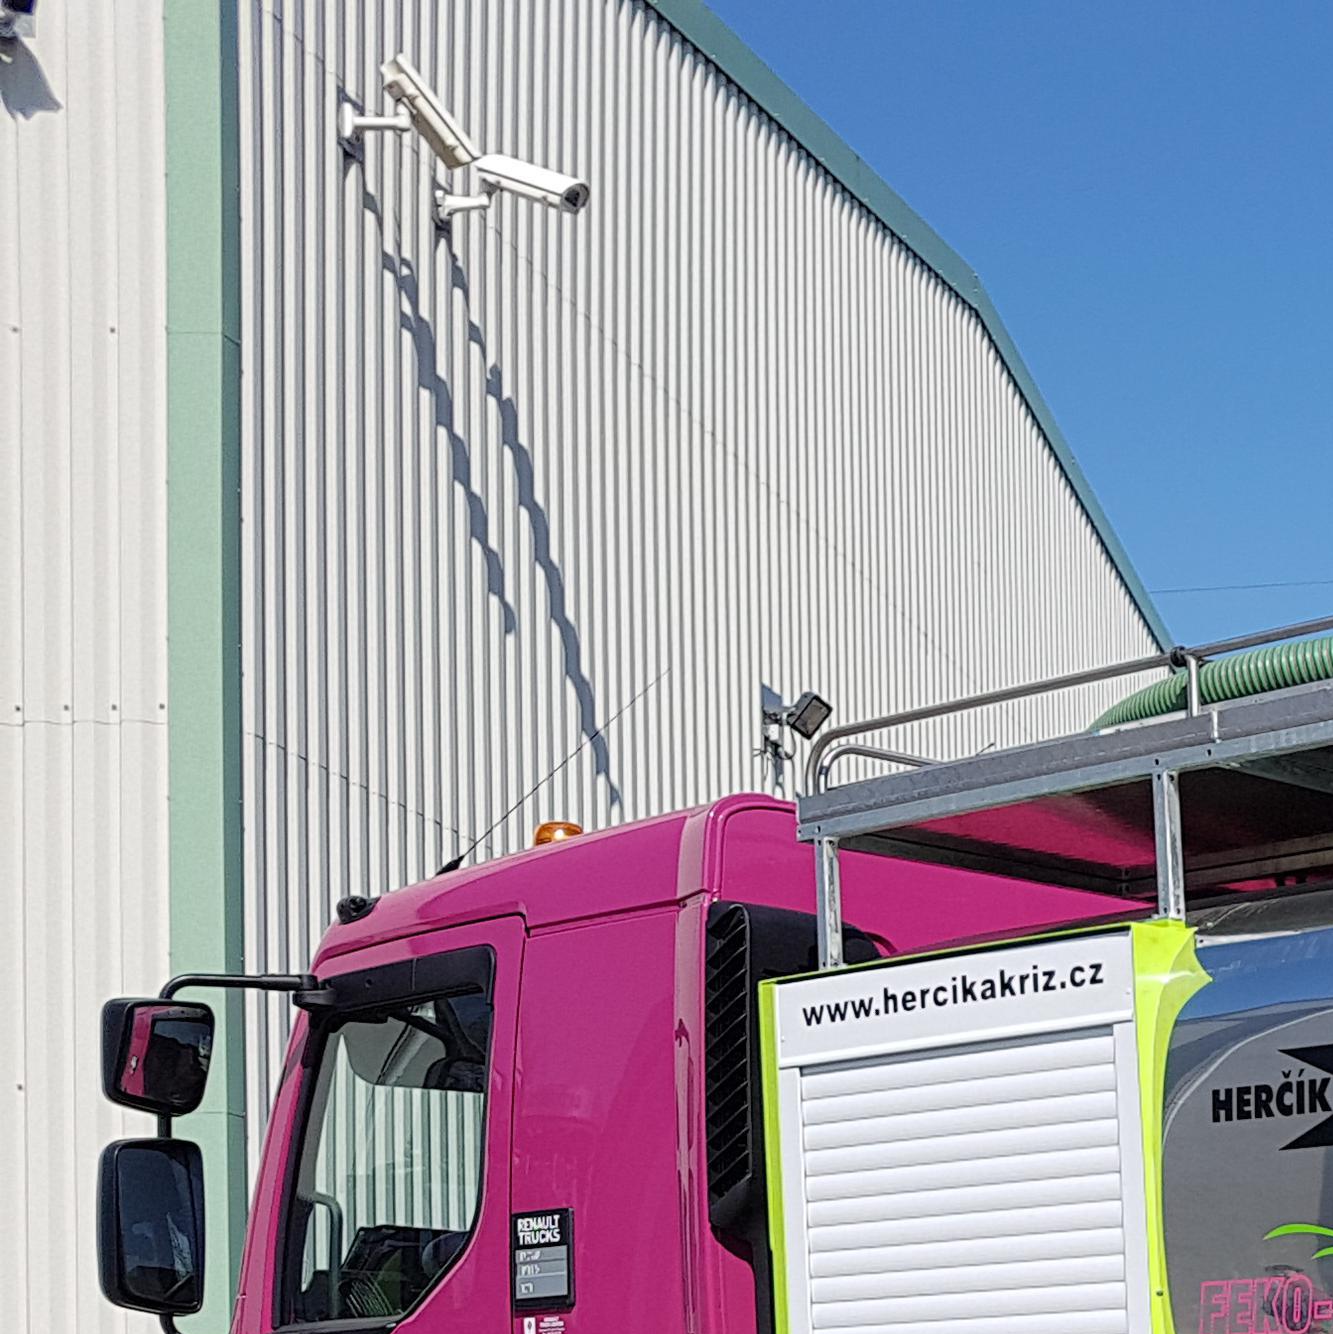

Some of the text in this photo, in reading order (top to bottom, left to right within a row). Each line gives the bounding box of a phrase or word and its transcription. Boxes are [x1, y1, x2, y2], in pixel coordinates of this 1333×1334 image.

[803, 963, 1104, 1026] www.hercikakriz.cz
[1212, 1069, 1332, 1122] HERČÍK
[517, 1215, 560, 1231] RENAULT
[519, 1229, 561, 1245] TRUCKS
